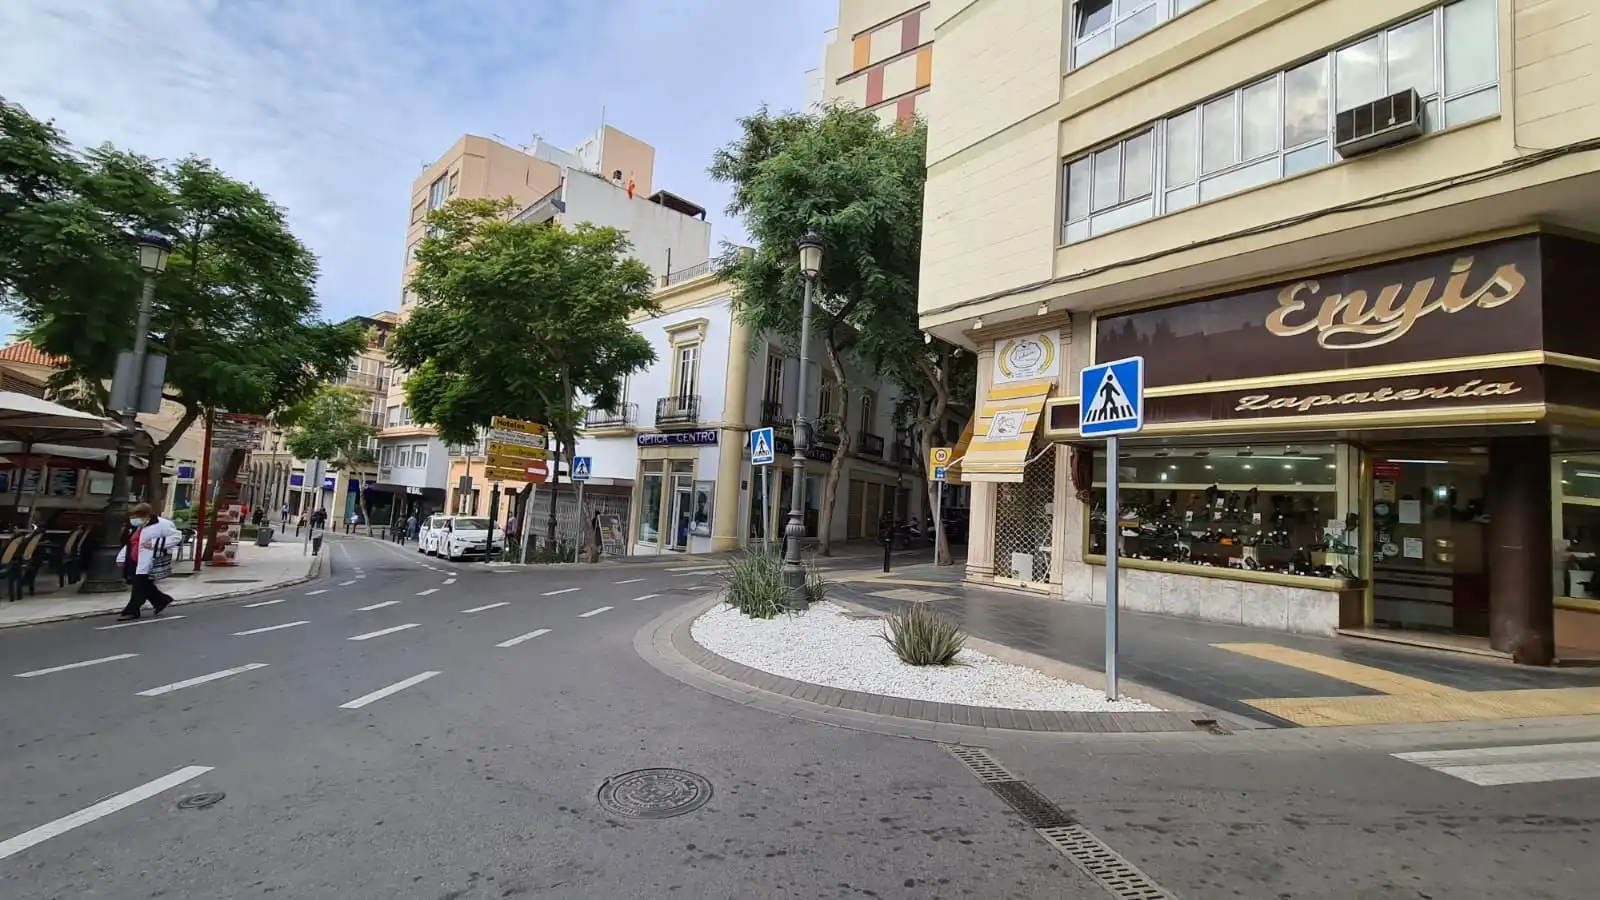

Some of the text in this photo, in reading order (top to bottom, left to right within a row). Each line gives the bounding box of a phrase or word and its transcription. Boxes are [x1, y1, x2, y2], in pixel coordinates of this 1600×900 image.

[1265, 256, 1526, 350] Enyis
[497, 418, 525, 430] Hoteles
[676, 430, 716, 443] CENTRO
